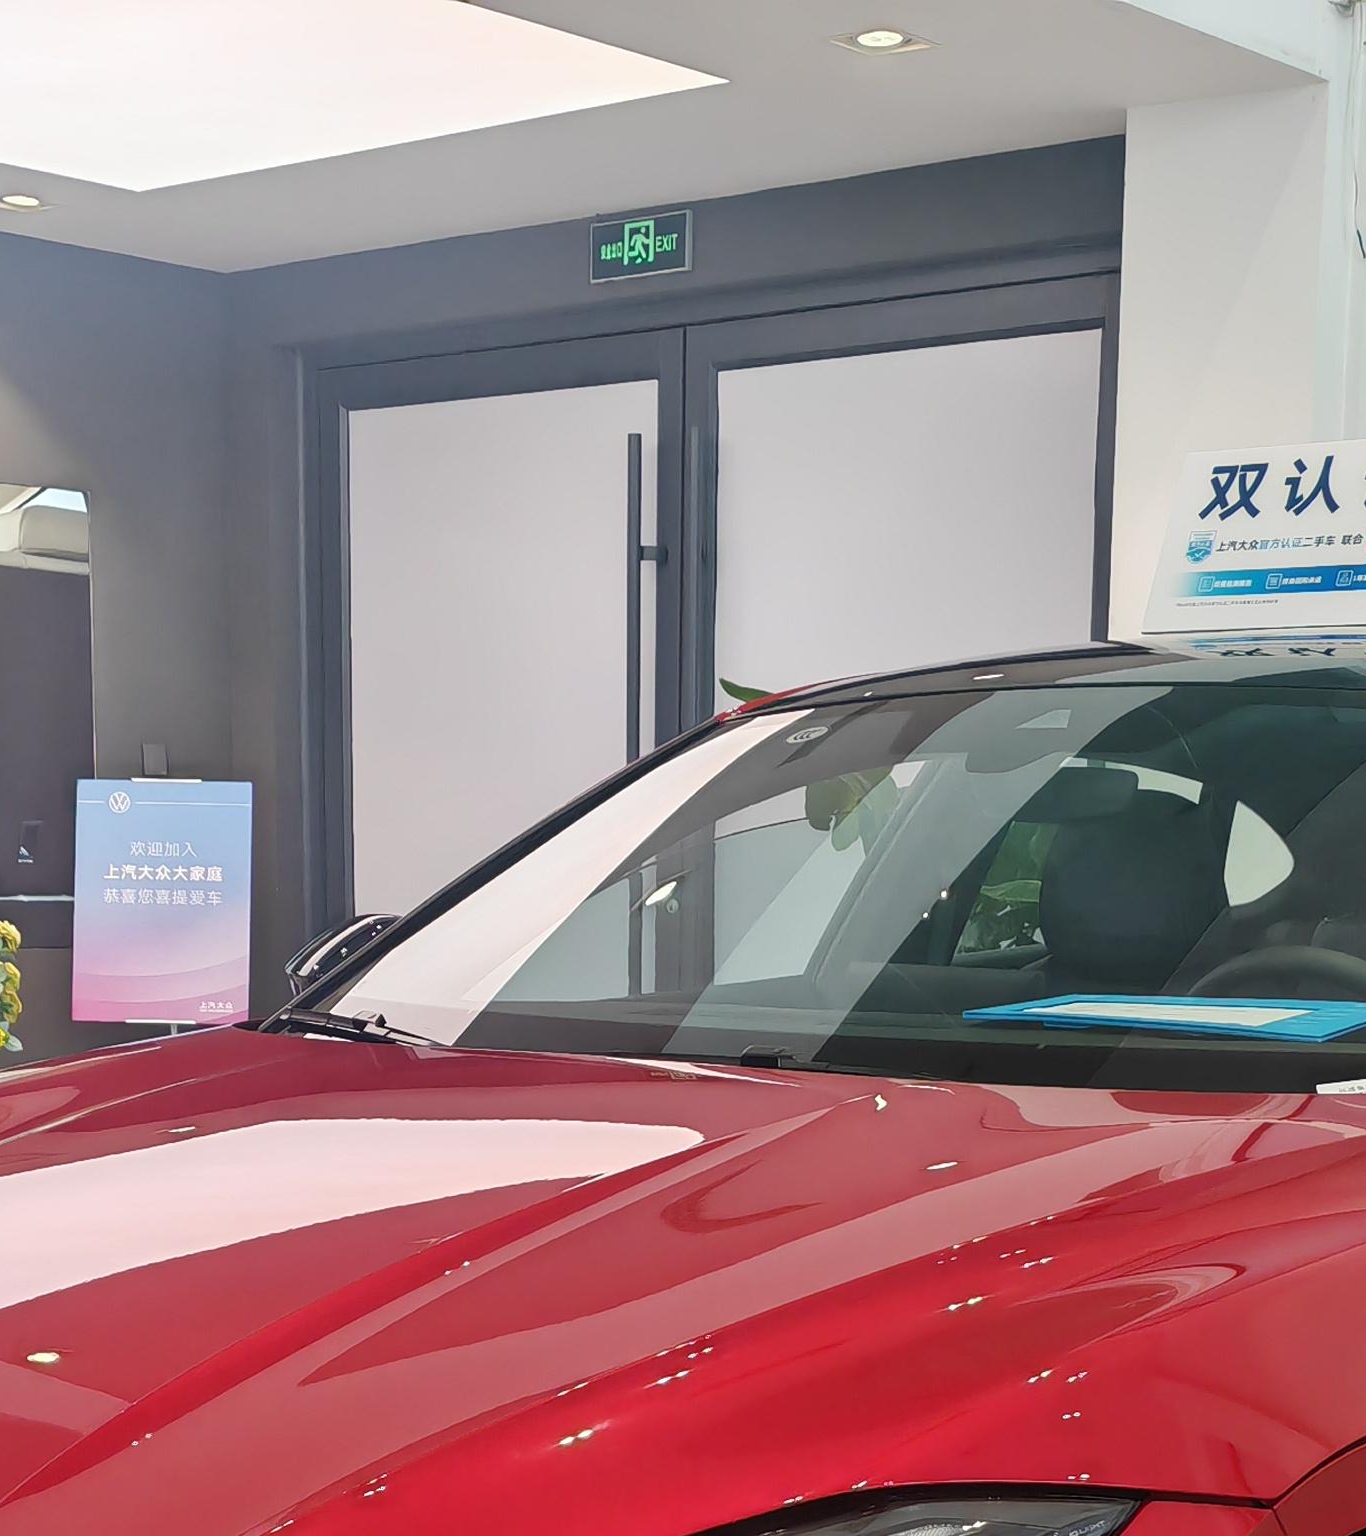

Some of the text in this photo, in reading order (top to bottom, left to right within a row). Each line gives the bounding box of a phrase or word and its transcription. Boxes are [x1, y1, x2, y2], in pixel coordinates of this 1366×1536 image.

[655, 233, 678, 252] EXIT
[1215, 535, 1336, 552] 上汽大众官方认证二手车
[1340, 533, 1364, 545] 联合
[130, 841, 197, 858] 欢迎加入
[103, 864, 223, 883] 上汽大众大家庭
[103, 888, 223, 907] 恭喜您喜提爱车
